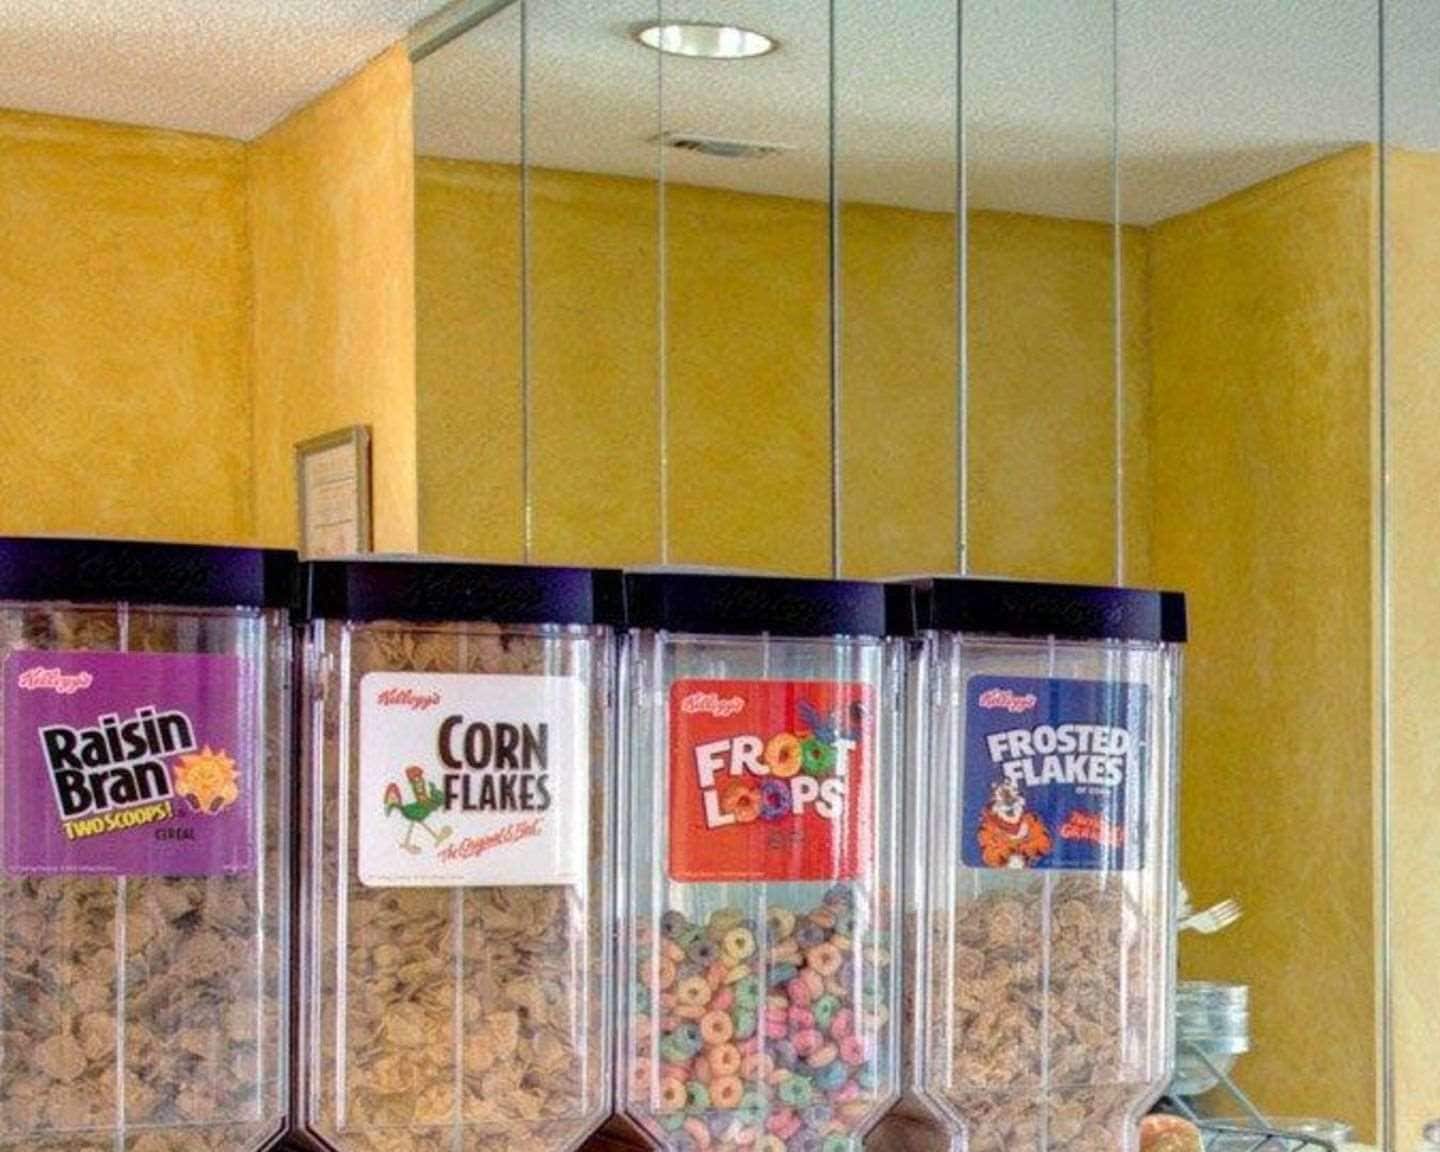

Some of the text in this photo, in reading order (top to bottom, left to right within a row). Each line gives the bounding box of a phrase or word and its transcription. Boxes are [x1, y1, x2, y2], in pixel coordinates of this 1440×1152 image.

[377, 688, 441, 711] Kellogg's
[41, 708, 195, 771] Raisin
[437, 714, 549, 771] CORN
[987, 724, 1130, 762] FROSTED
[695, 734, 857, 788] FROOT
[1002, 754, 1124, 787] FLAKES
[53, 760, 171, 817] Bran
[443, 773, 552, 812] FLAKES
[703, 775, 846, 829] LOOPS
[64, 802, 173, 840] TWO SCOOPS!
[155, 828, 195, 841] CEREAL
